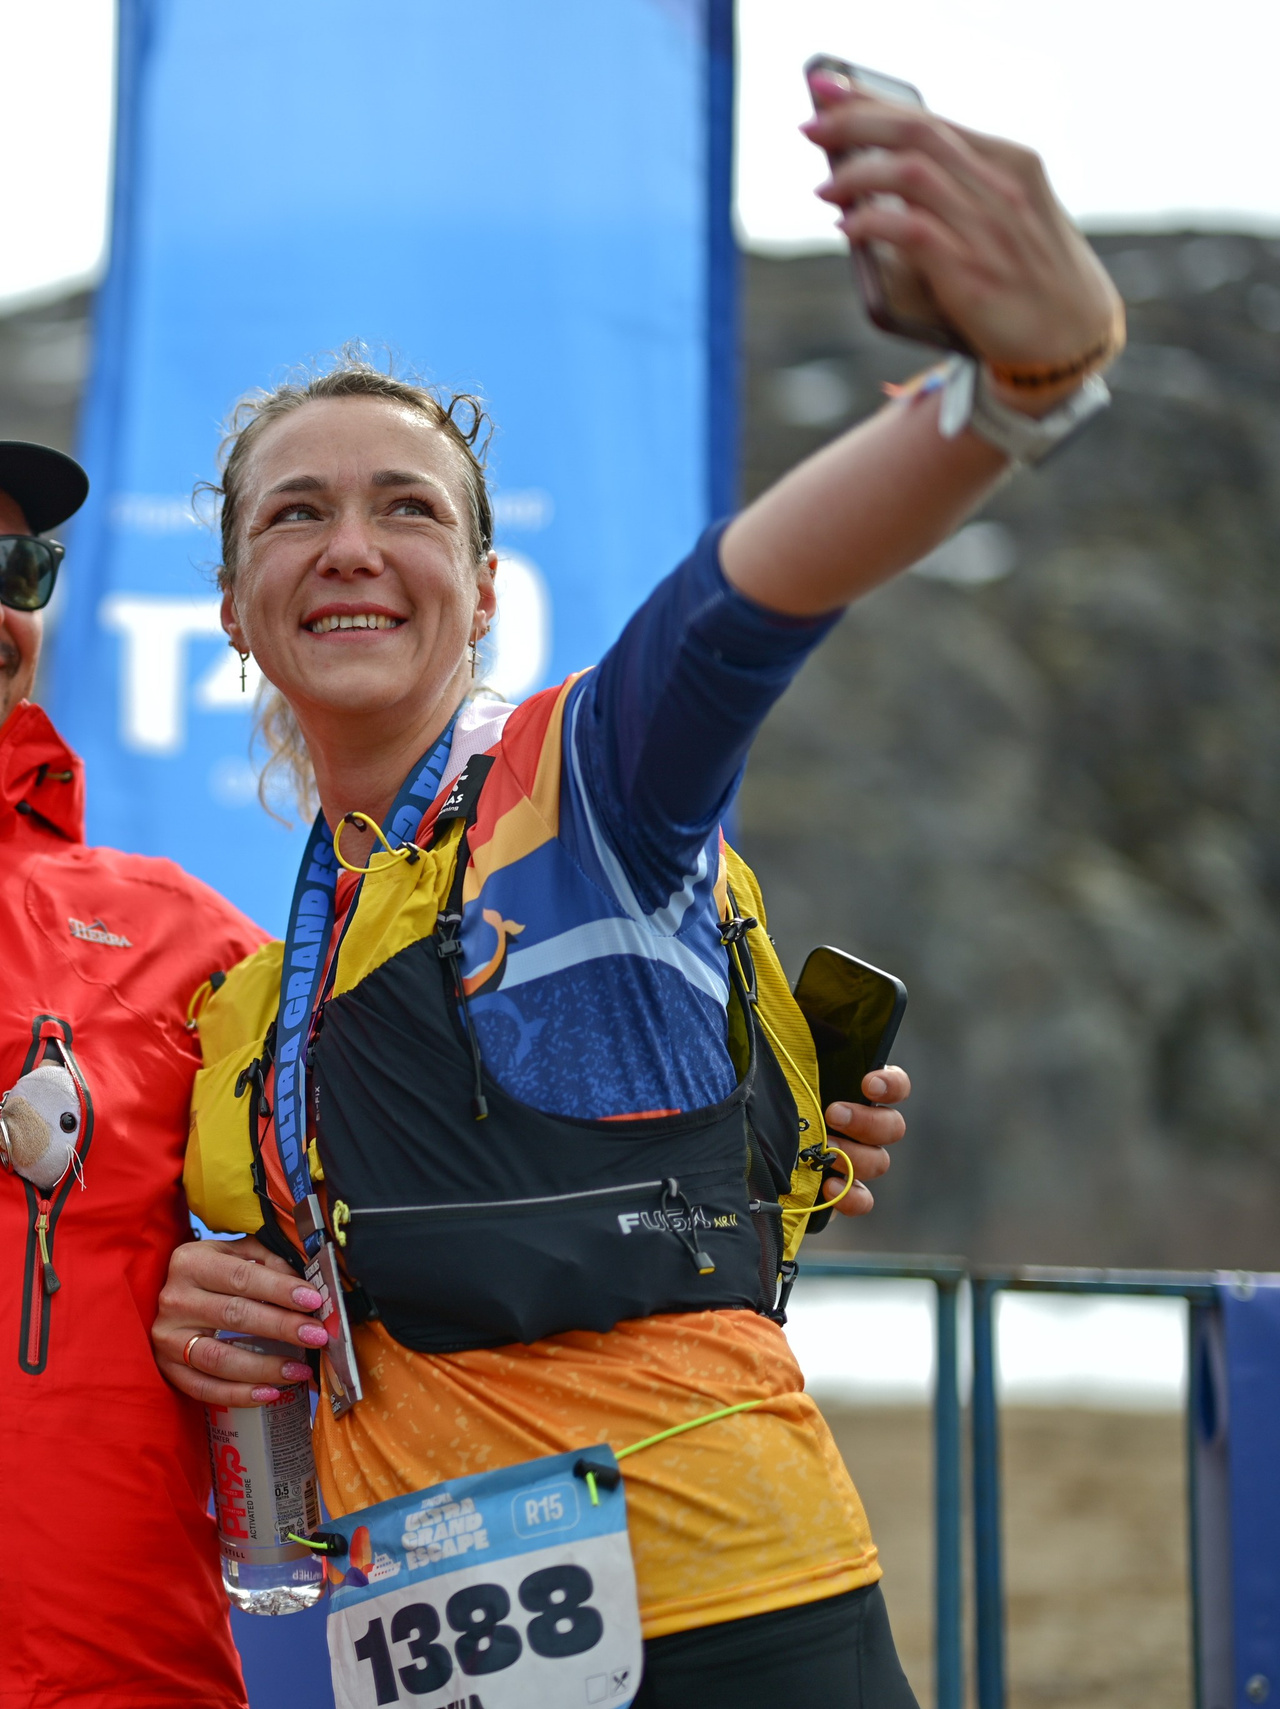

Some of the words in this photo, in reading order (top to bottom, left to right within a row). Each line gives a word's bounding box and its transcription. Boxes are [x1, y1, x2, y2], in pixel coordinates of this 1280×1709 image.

[283, 889, 330, 1030] GRAND
[276, 1031, 302, 1176] ULTRA
[244, 1479, 252, 1498] PURE
[246, 1499, 258, 1540] ACTIVATED
[404, 1497, 476, 1532] ULTRA
[524, 1493, 564, 1527] R15
[401, 1512, 484, 1550] GRAND
[405, 1528, 490, 1571] ESCAPE
[224, 1547, 245, 1559] STILL
[353, 1563, 605, 1707] 1388
